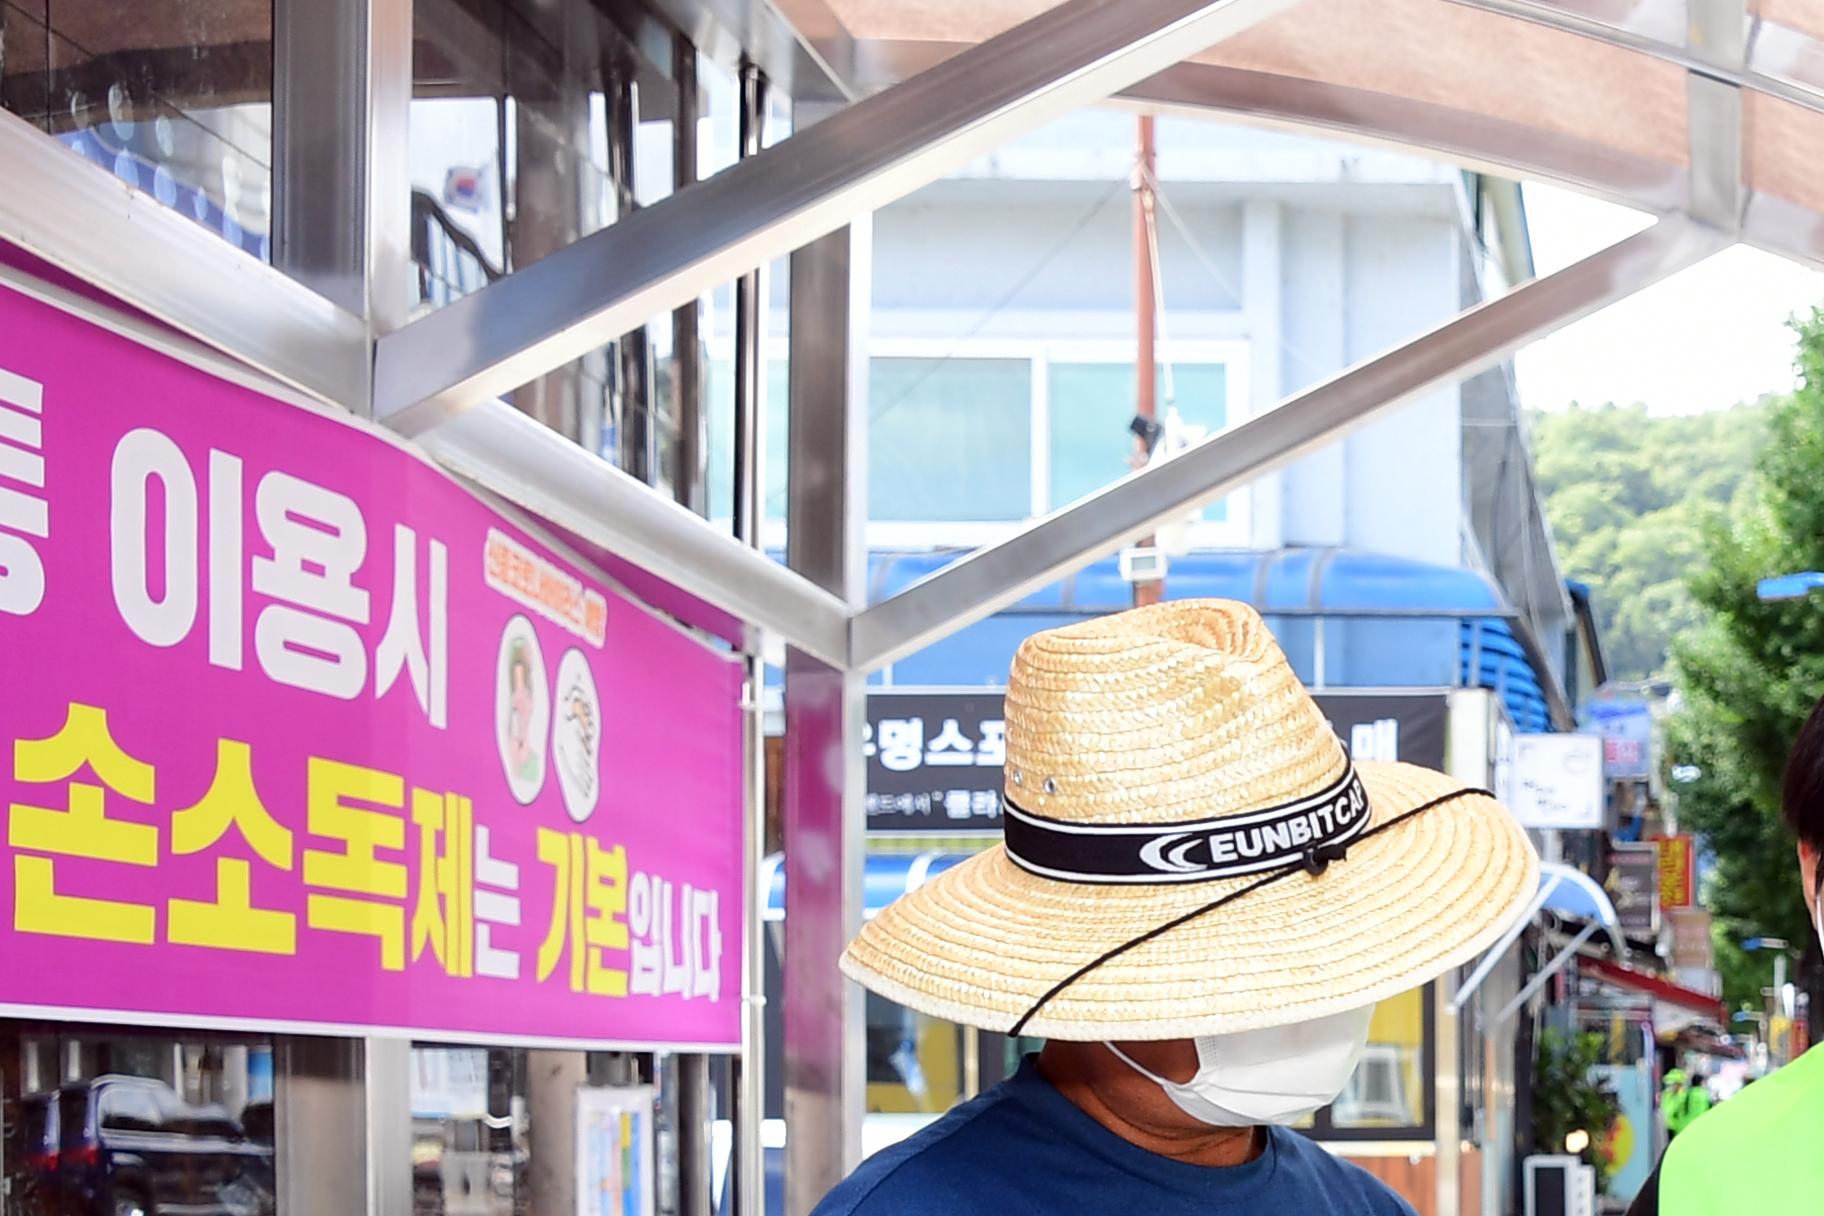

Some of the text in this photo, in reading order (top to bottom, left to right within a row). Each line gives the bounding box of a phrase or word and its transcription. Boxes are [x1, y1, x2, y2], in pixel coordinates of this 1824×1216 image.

[111, 427, 447, 730] 이용시
[8, 701, 722, 1002] 손소독제는 기본입니다
[862, 716, 1005, 771] 명스포
